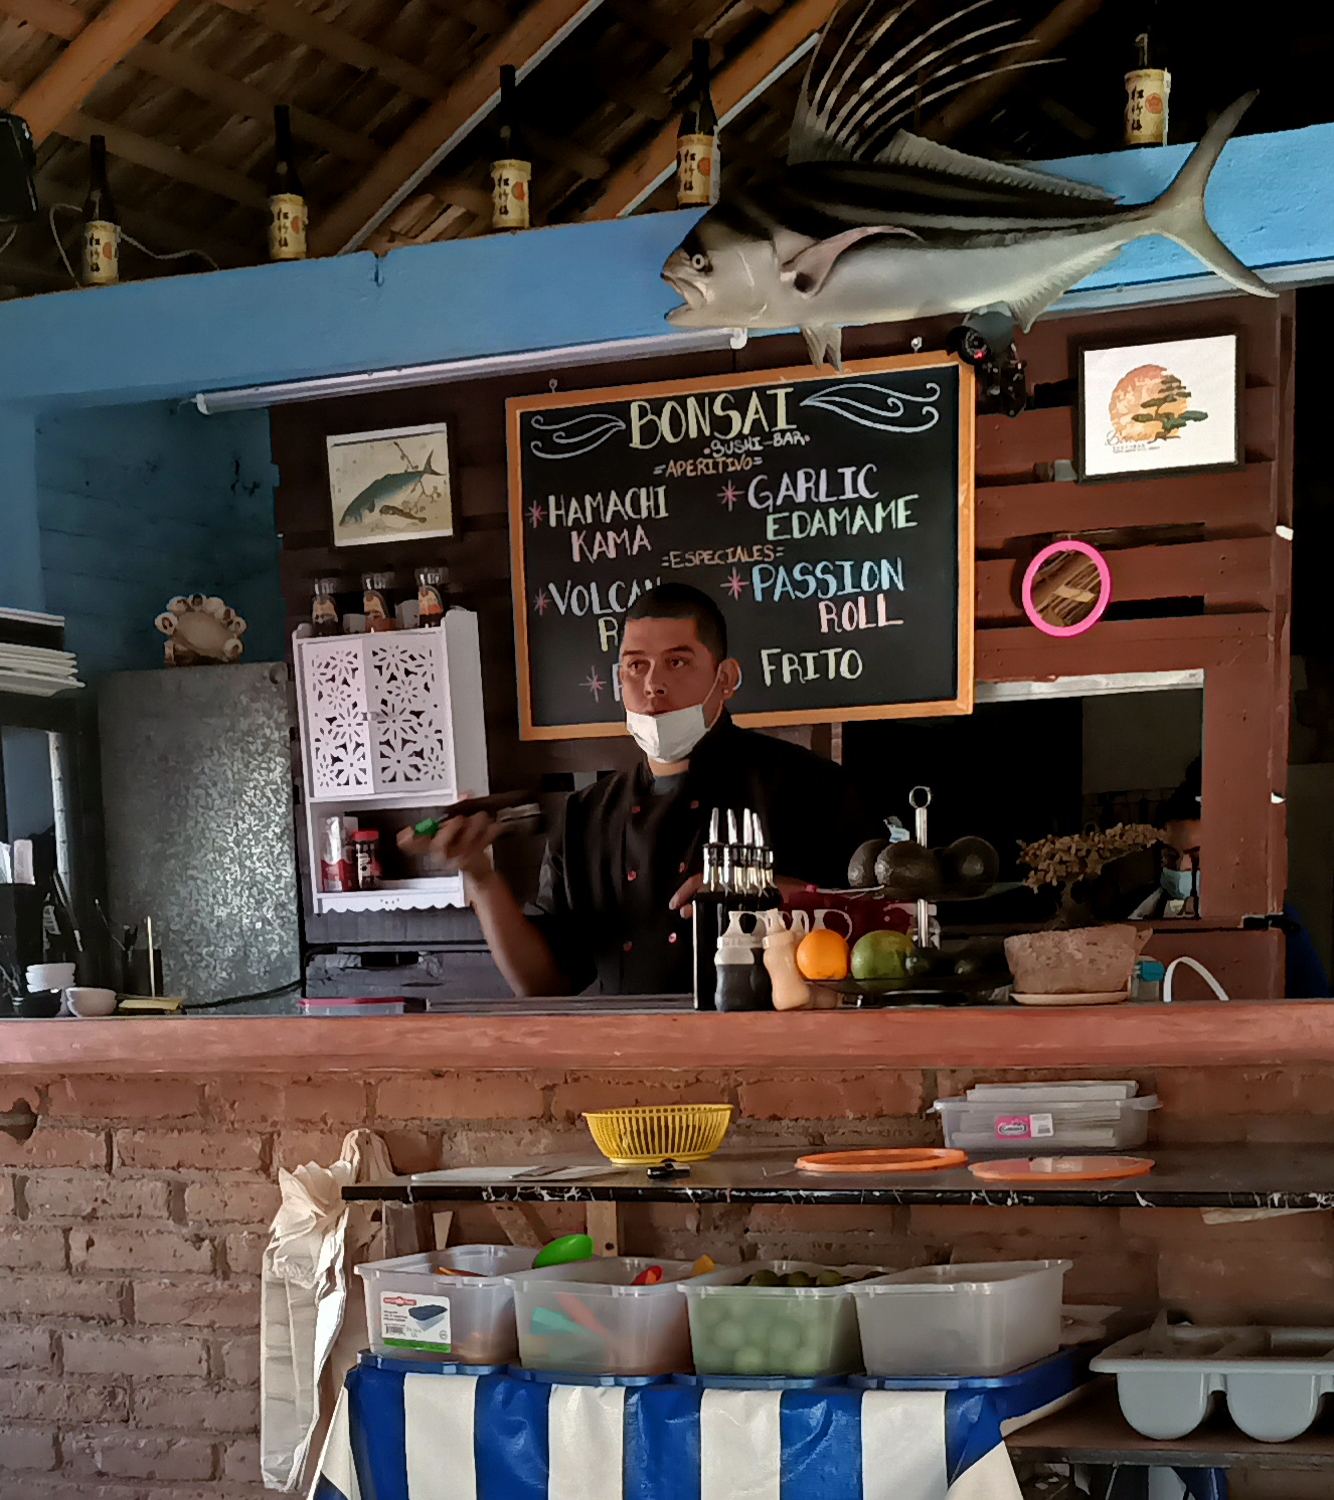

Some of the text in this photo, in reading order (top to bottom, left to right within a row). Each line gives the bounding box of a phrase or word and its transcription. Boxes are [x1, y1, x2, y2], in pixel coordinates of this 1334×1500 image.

[629, 387, 797, 449] BONSAI
[666, 454, 754, 478] APERITIVO
[547, 485, 669, 527] HAMACHI
[748, 464, 879, 511] GARLIC
[766, 494, 919, 541] EDAMAME
[571, 525, 652, 563] KAMA
[670, 545, 774, 568] ESPECIALES
[548, 576, 661, 617] VOLCA
[752, 557, 905, 602] PASSION
[819, 593, 904, 633] ROLL
[761, 647, 863, 687] FRITO
